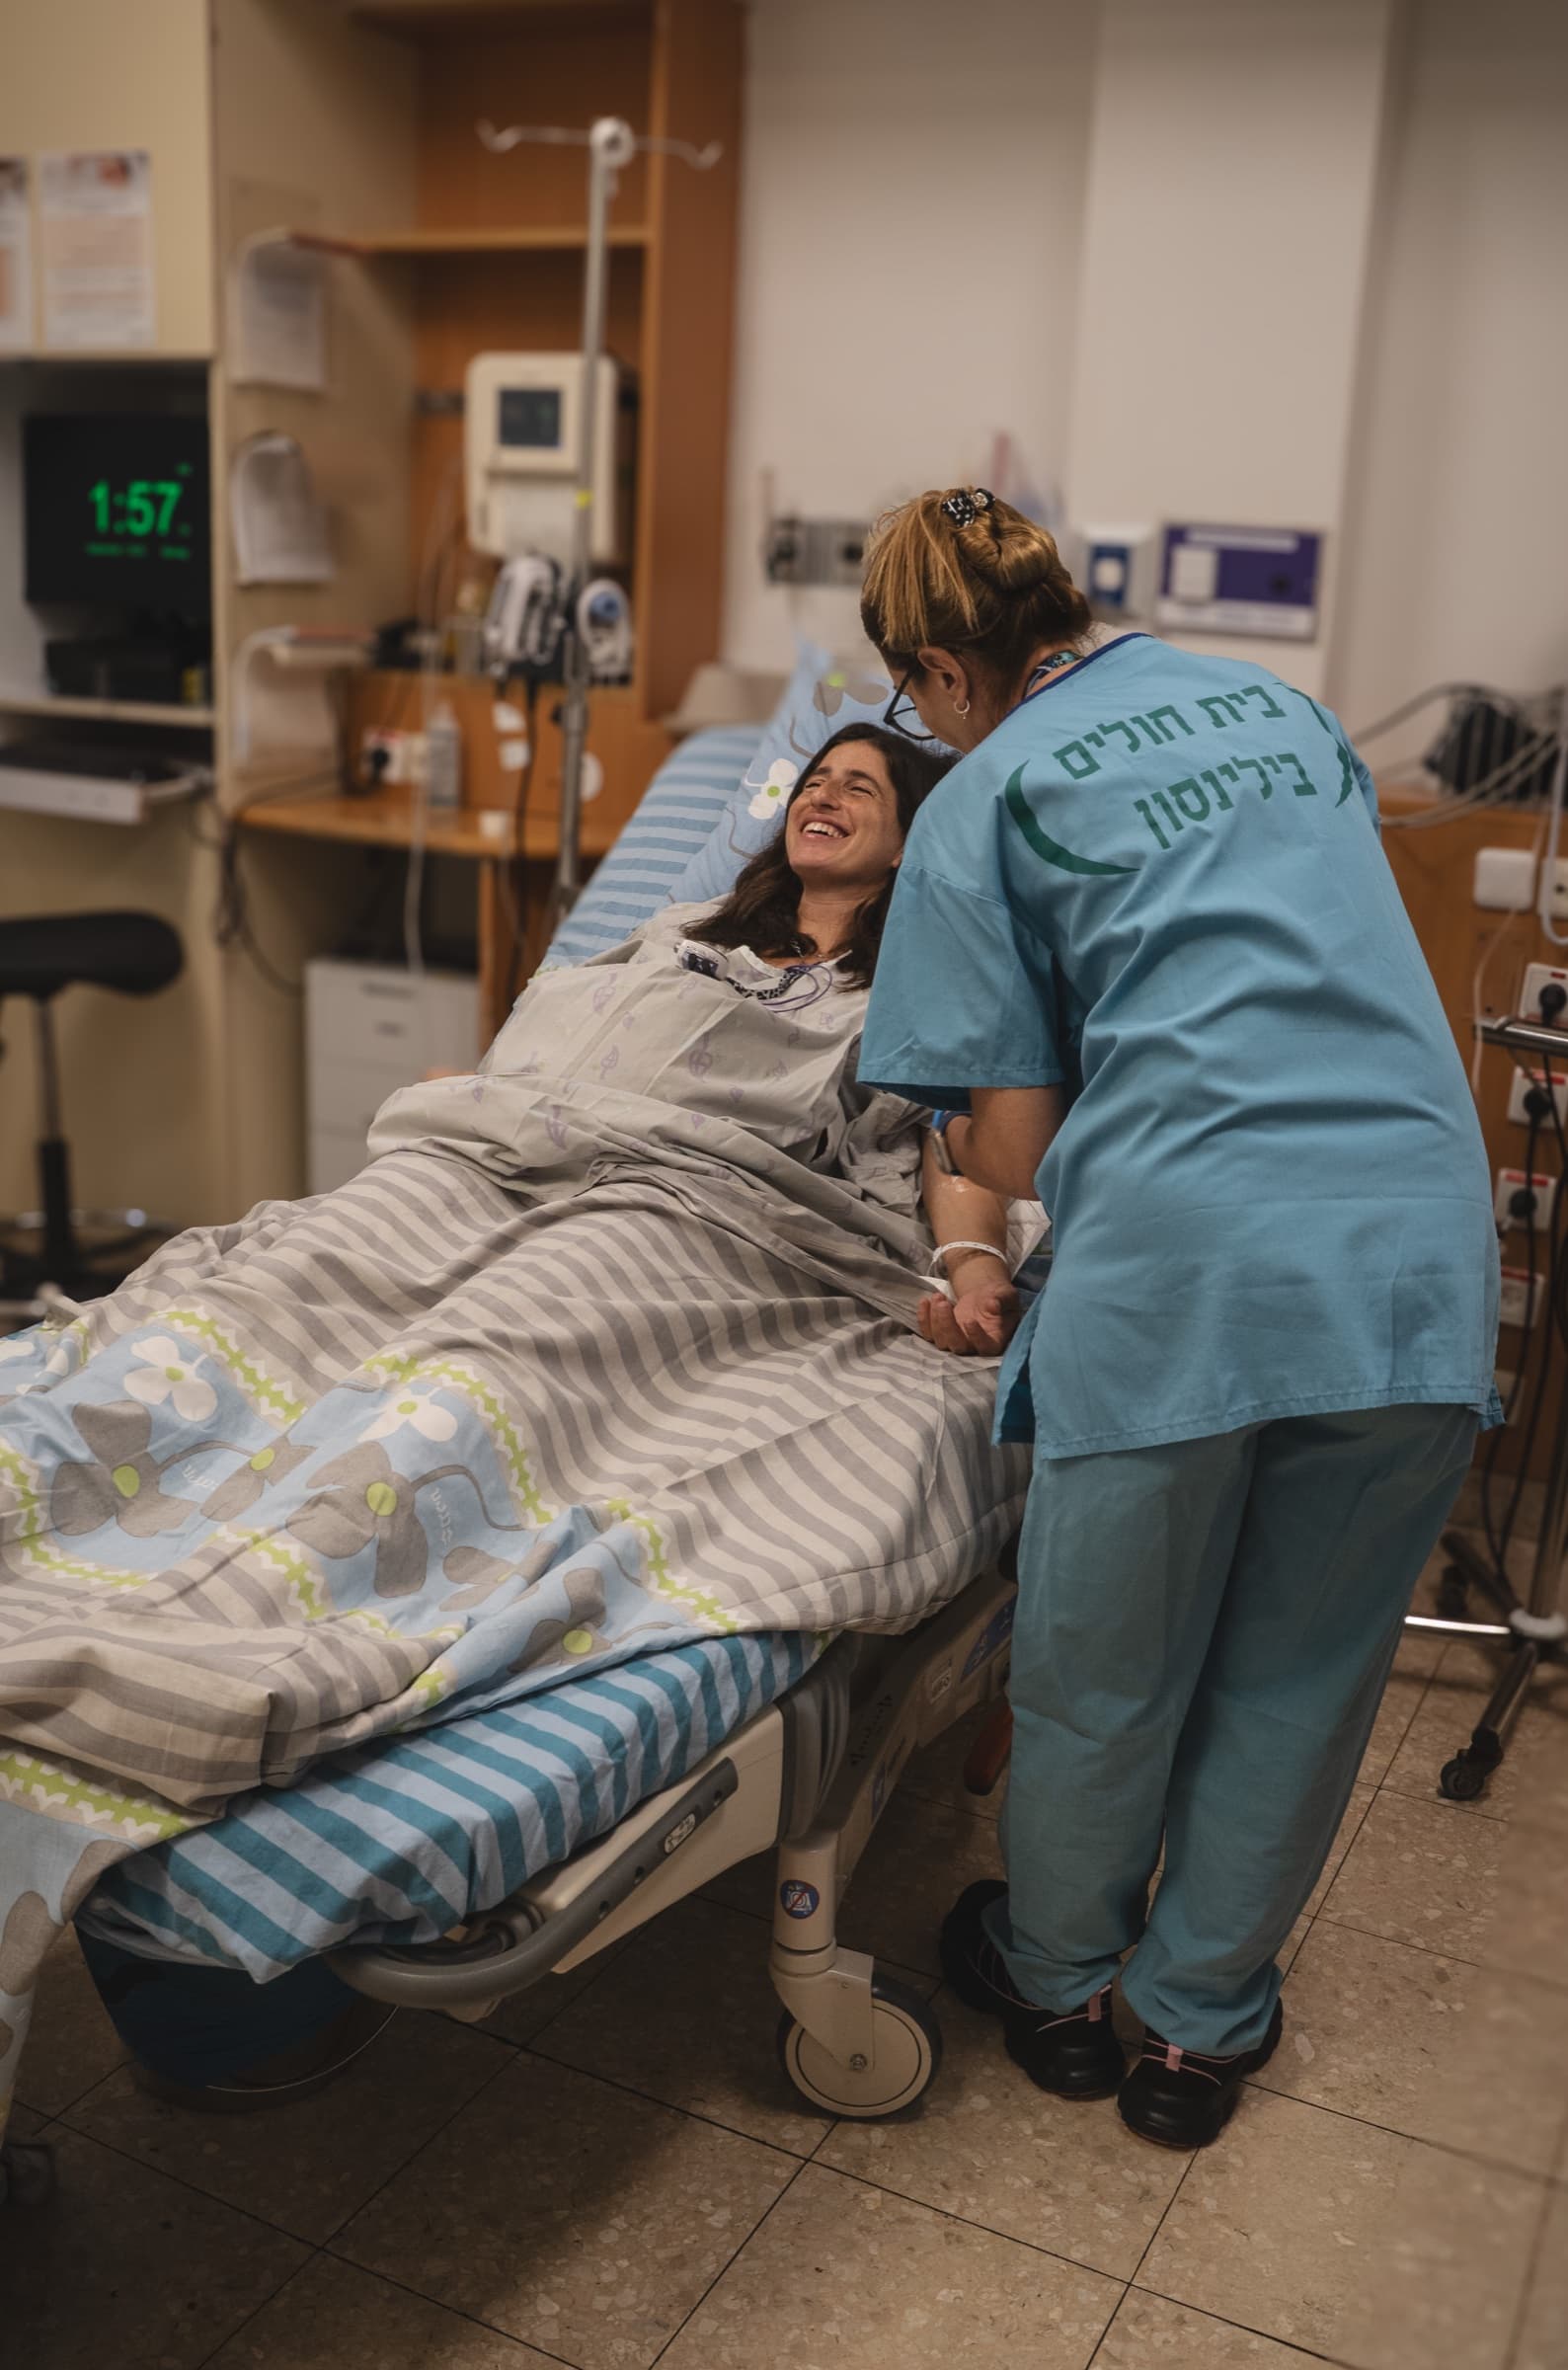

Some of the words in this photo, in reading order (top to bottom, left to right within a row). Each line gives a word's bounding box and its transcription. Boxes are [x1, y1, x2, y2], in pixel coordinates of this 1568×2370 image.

[89, 480, 182, 537] 1:57
[1195, 684, 1287, 729] בית
[1052, 704, 1195, 780] חולים
[1133, 752, 1317, 849] בילינסון
